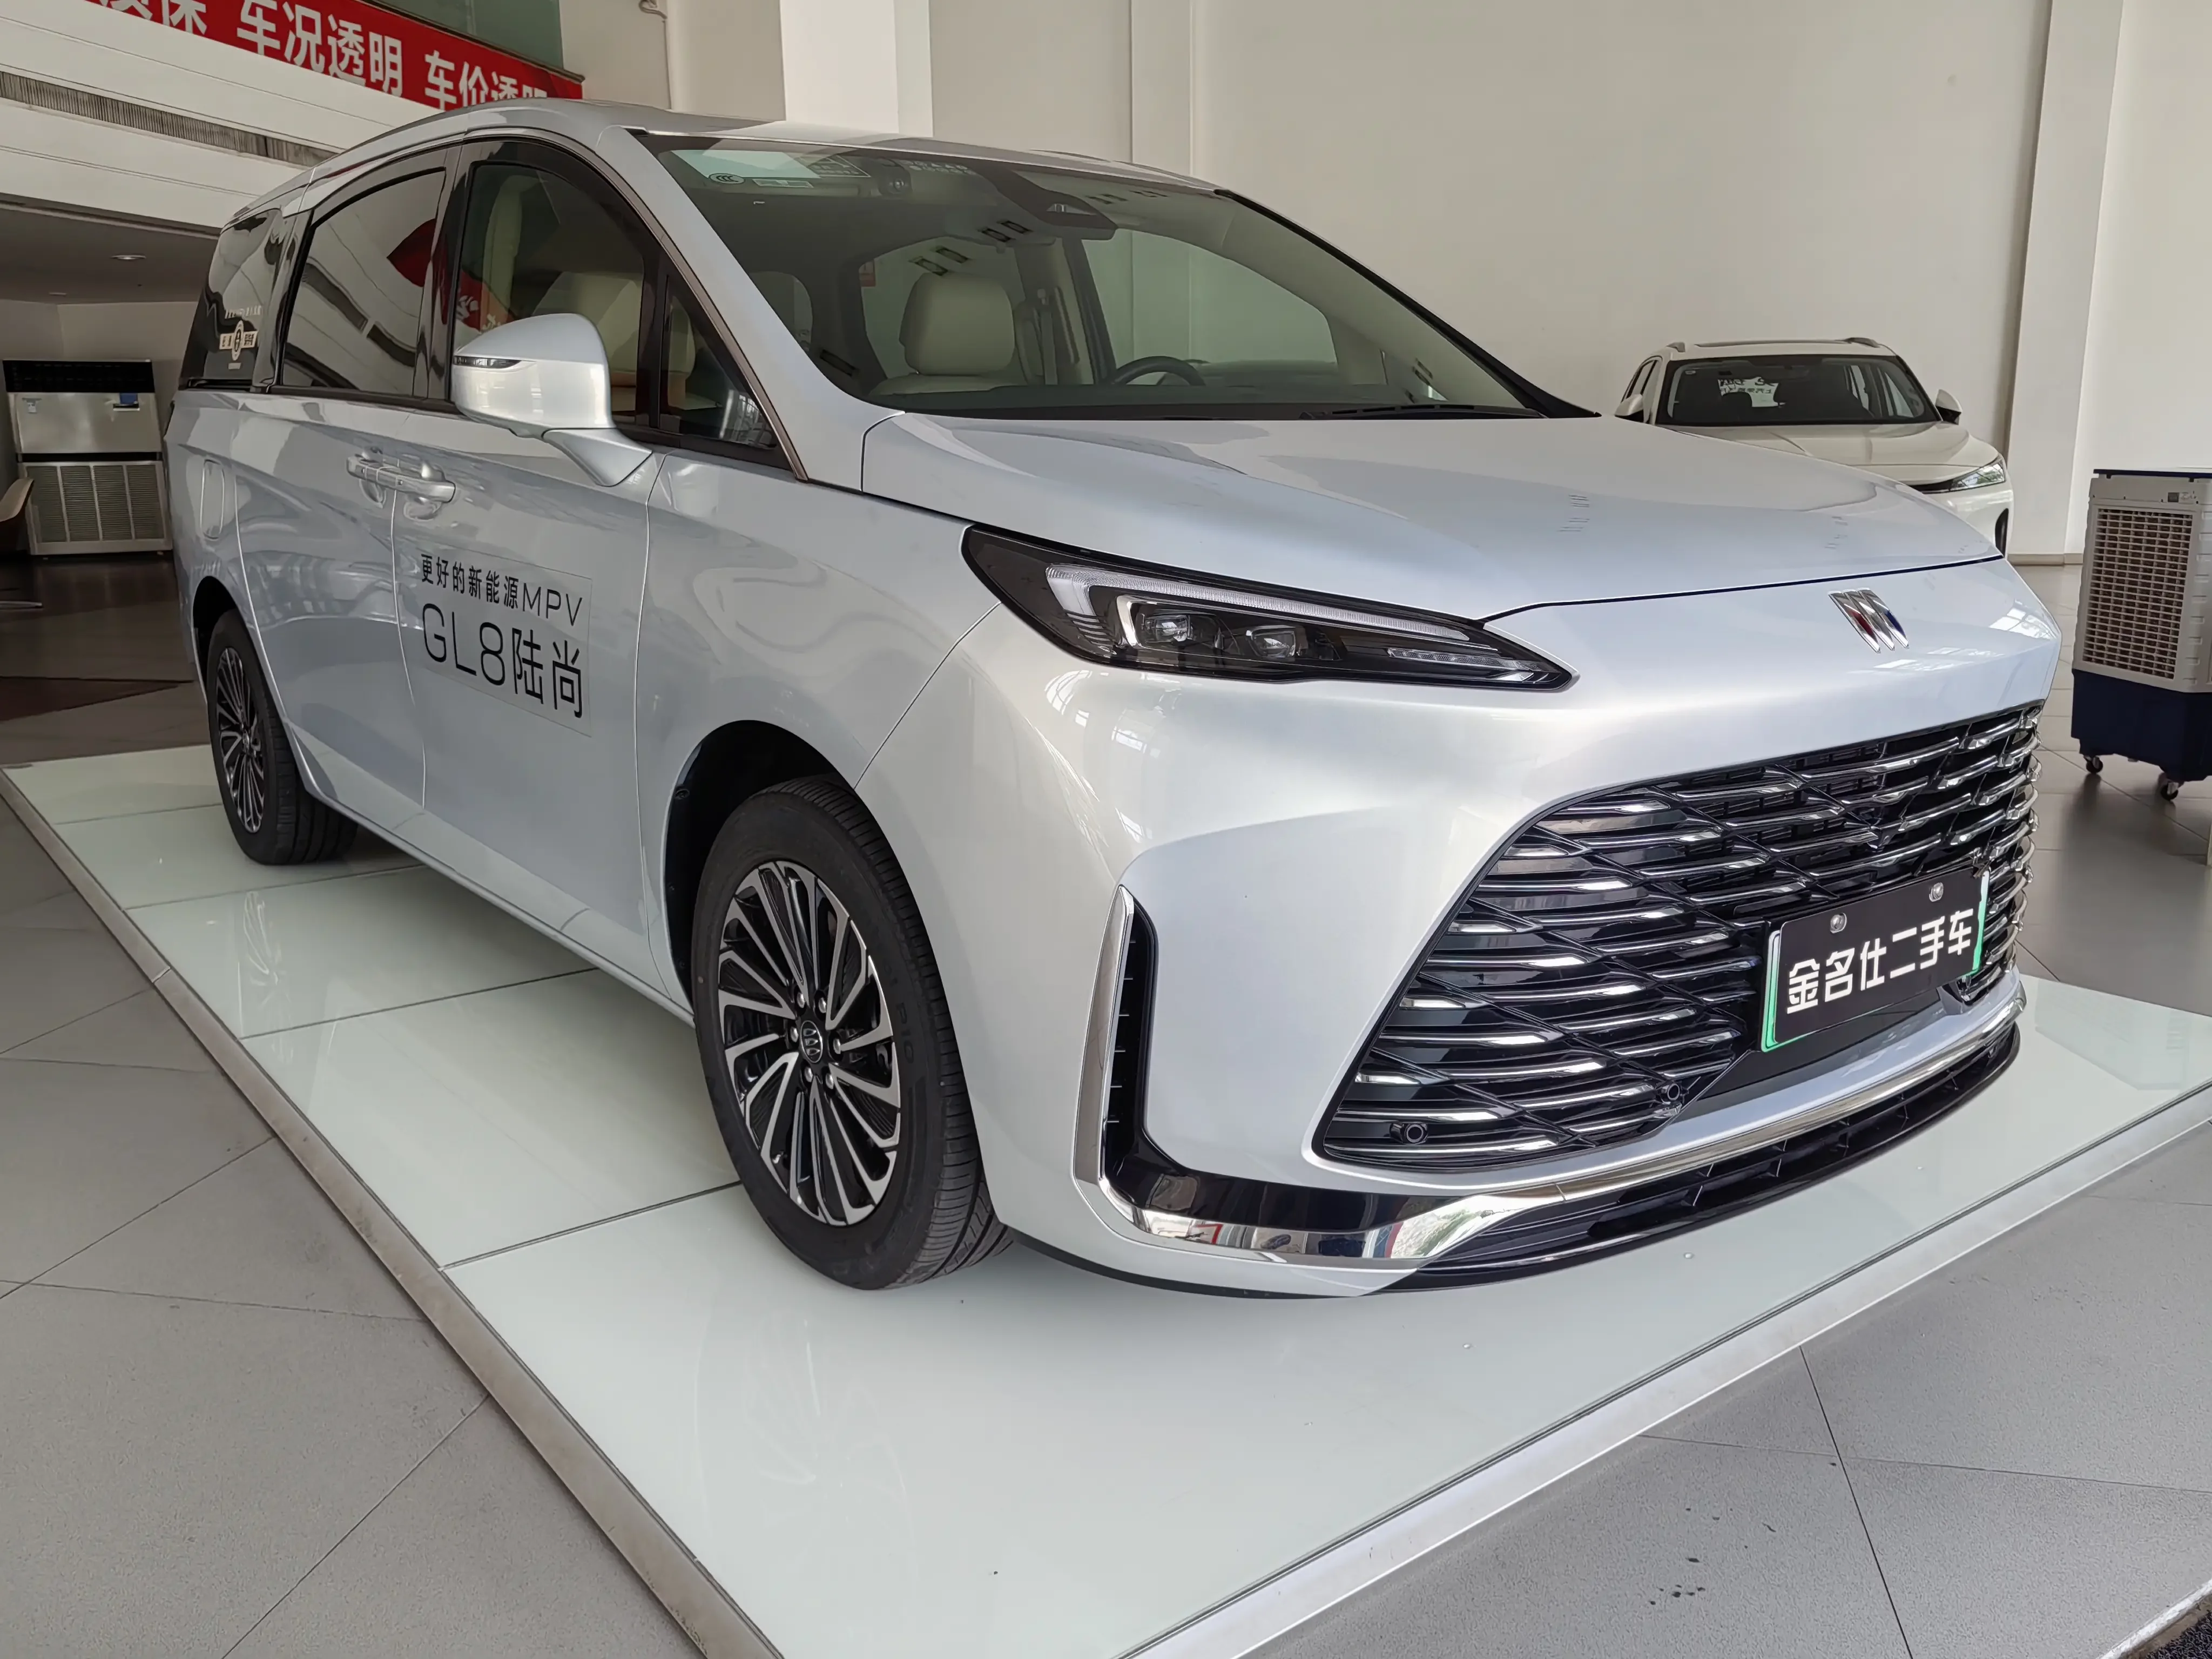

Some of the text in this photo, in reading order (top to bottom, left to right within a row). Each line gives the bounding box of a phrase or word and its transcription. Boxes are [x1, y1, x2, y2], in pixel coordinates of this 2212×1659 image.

[237, 0, 403, 98] 车况透明
[421, 554, 583, 626] 更好的新能源MPV
[422, 603, 583, 718] GL8陆尚
[1786, 908, 1974, 1014] 金名仕二手车
